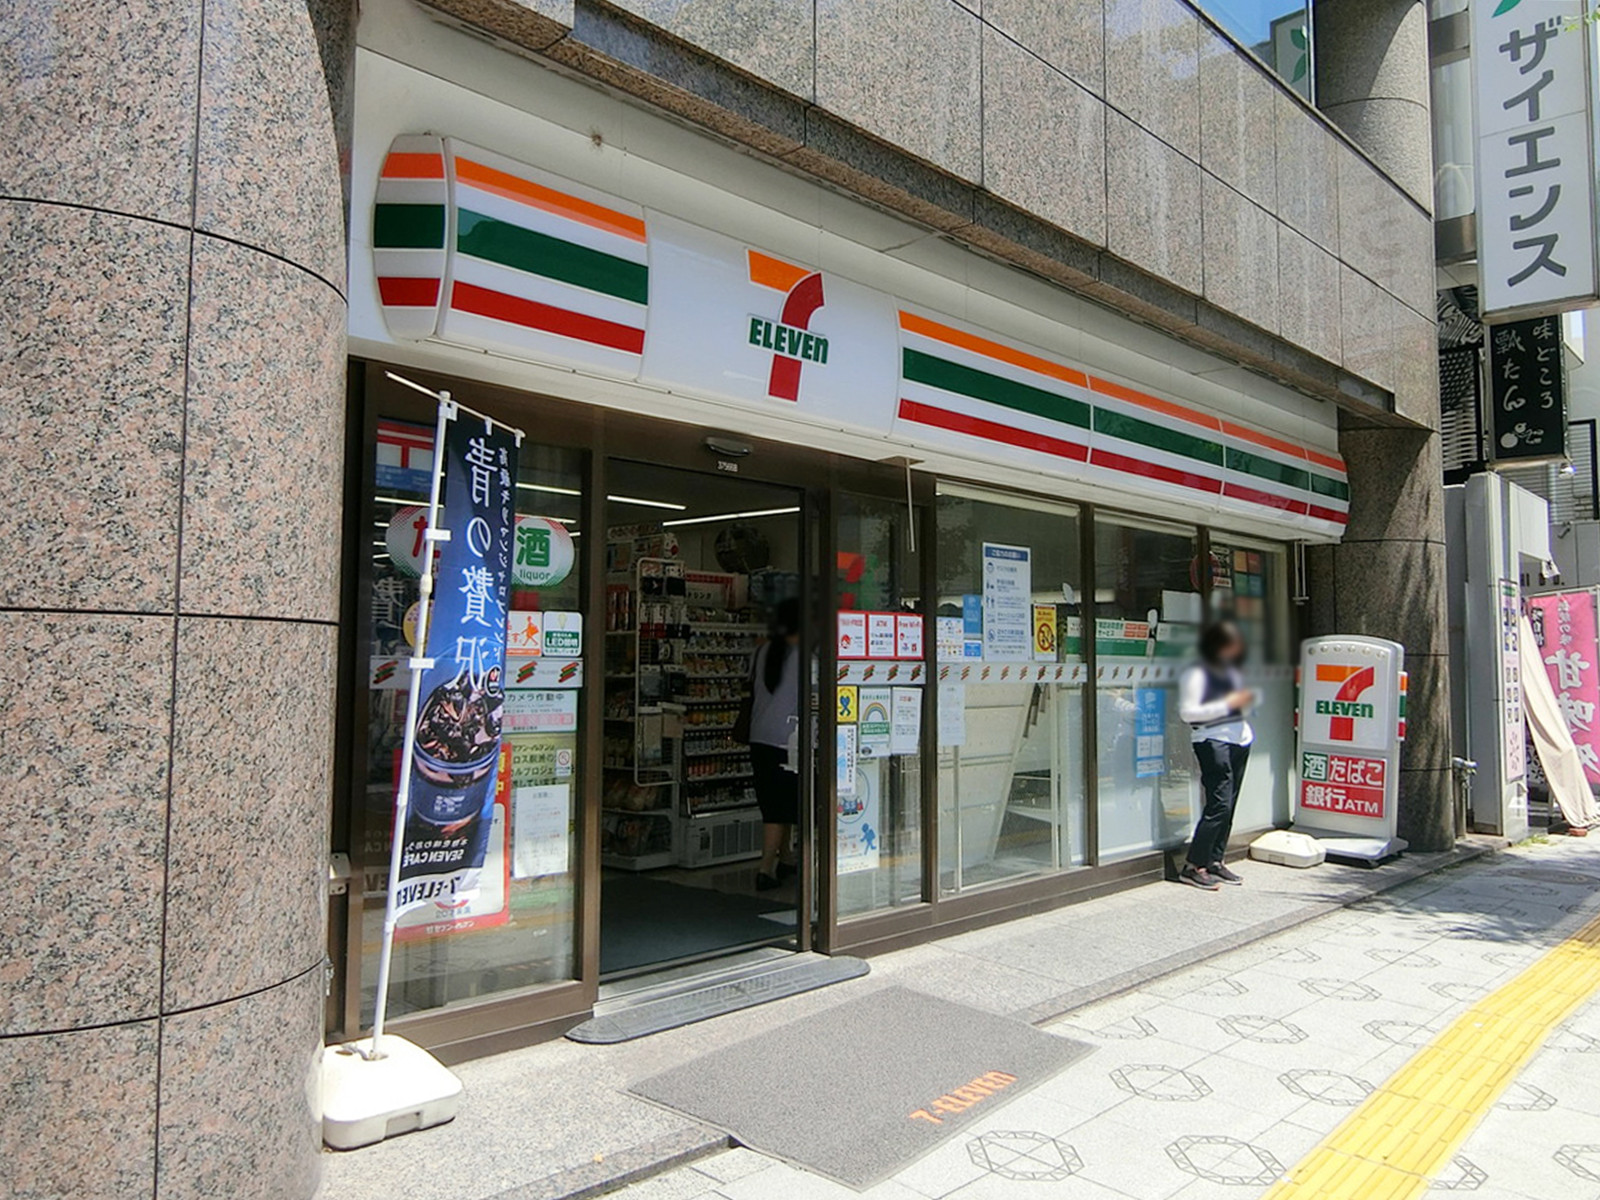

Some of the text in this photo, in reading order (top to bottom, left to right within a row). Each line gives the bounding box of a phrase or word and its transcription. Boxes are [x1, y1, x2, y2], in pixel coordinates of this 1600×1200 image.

[1499, 15, 1567, 287] ザイエンス
[748, 249, 825, 402] 7
[1532, 318, 1555, 409] 味どころ
[516, 525, 551, 567] 酒
[519, 568, 551, 581] liquor
[1316, 664, 1374, 741] 7
[1304, 753, 1384, 787] 酒 たばこ
